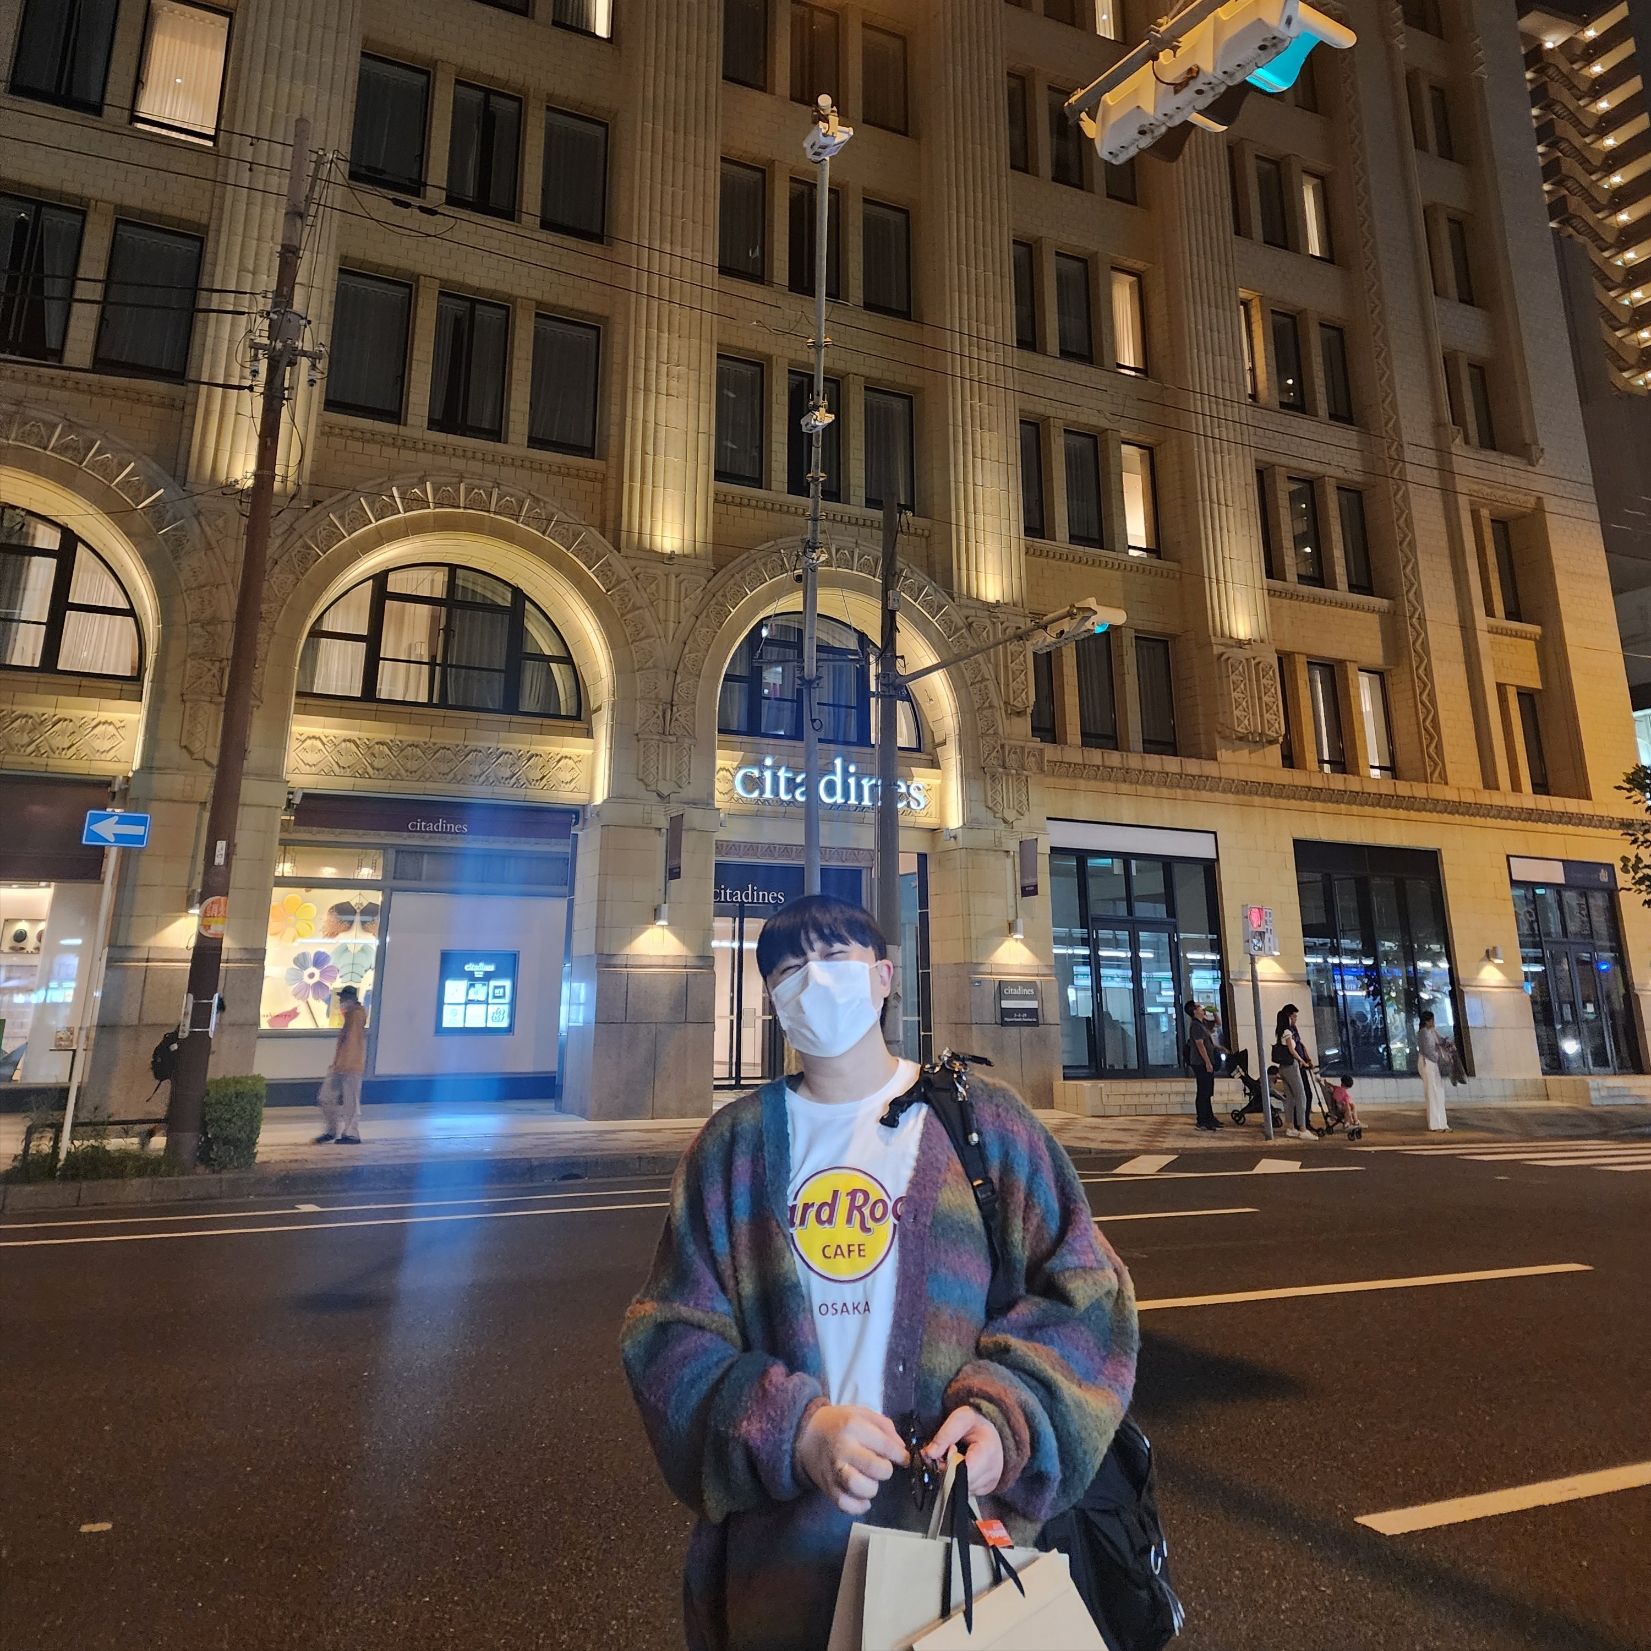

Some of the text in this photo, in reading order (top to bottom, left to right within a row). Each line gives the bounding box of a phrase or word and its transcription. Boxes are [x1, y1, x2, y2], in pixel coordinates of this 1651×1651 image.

[407, 818, 469, 833] citadines
[713, 883, 786, 904] citadines
[1003, 985, 1035, 995] citadines
[821, 1243, 867, 1260] CAFE
[818, 1300, 872, 1317] OSAKA
